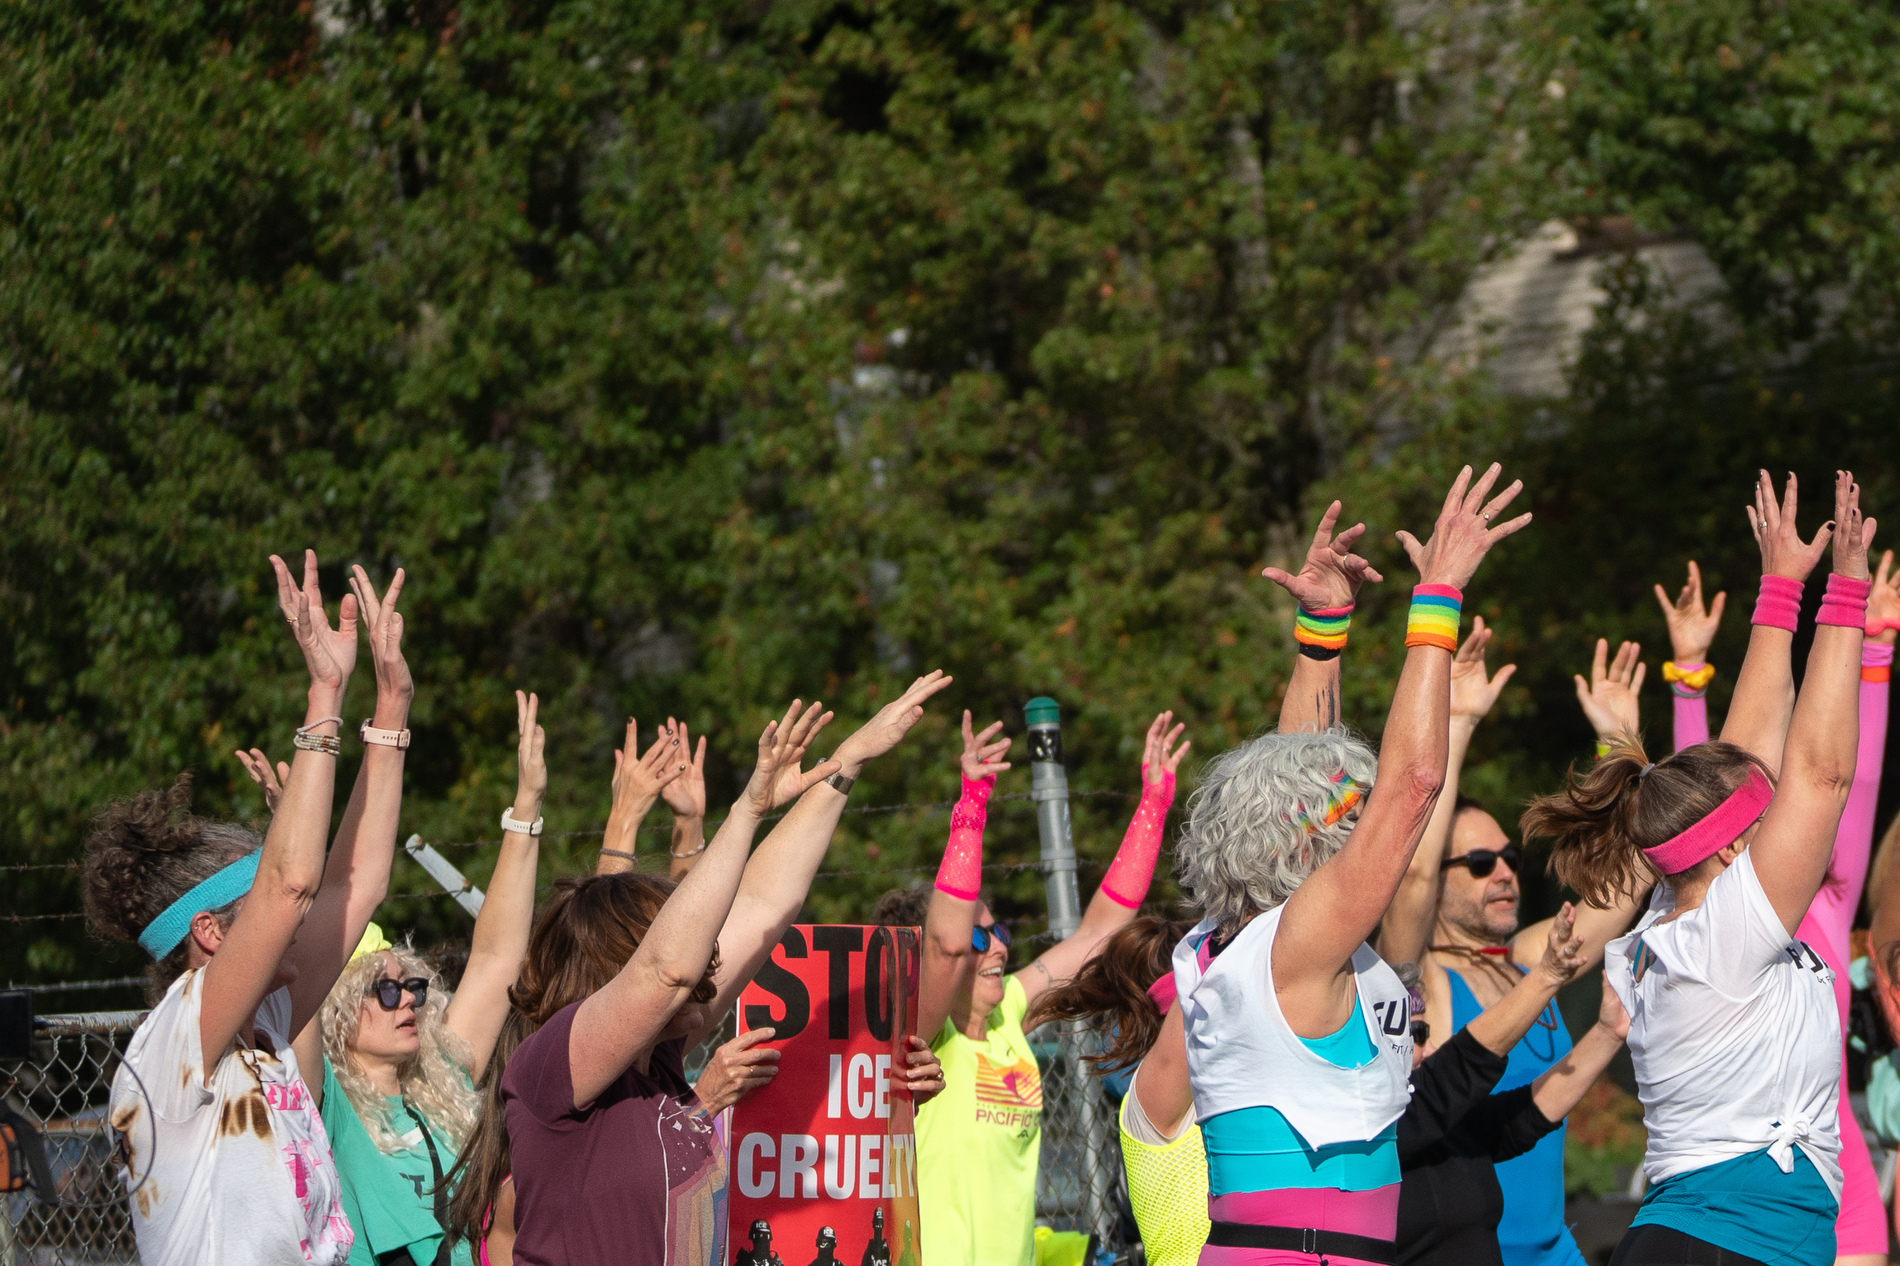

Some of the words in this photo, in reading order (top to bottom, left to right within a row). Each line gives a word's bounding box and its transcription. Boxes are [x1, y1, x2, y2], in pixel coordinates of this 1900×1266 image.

[744, 926, 919, 1042] STOP
[827, 1052, 892, 1119] ICE
[976, 1109, 1033, 1128] PACIFIC
[737, 1132, 915, 1200] CRUELTY
[755, 1222, 768, 1230] ICE
